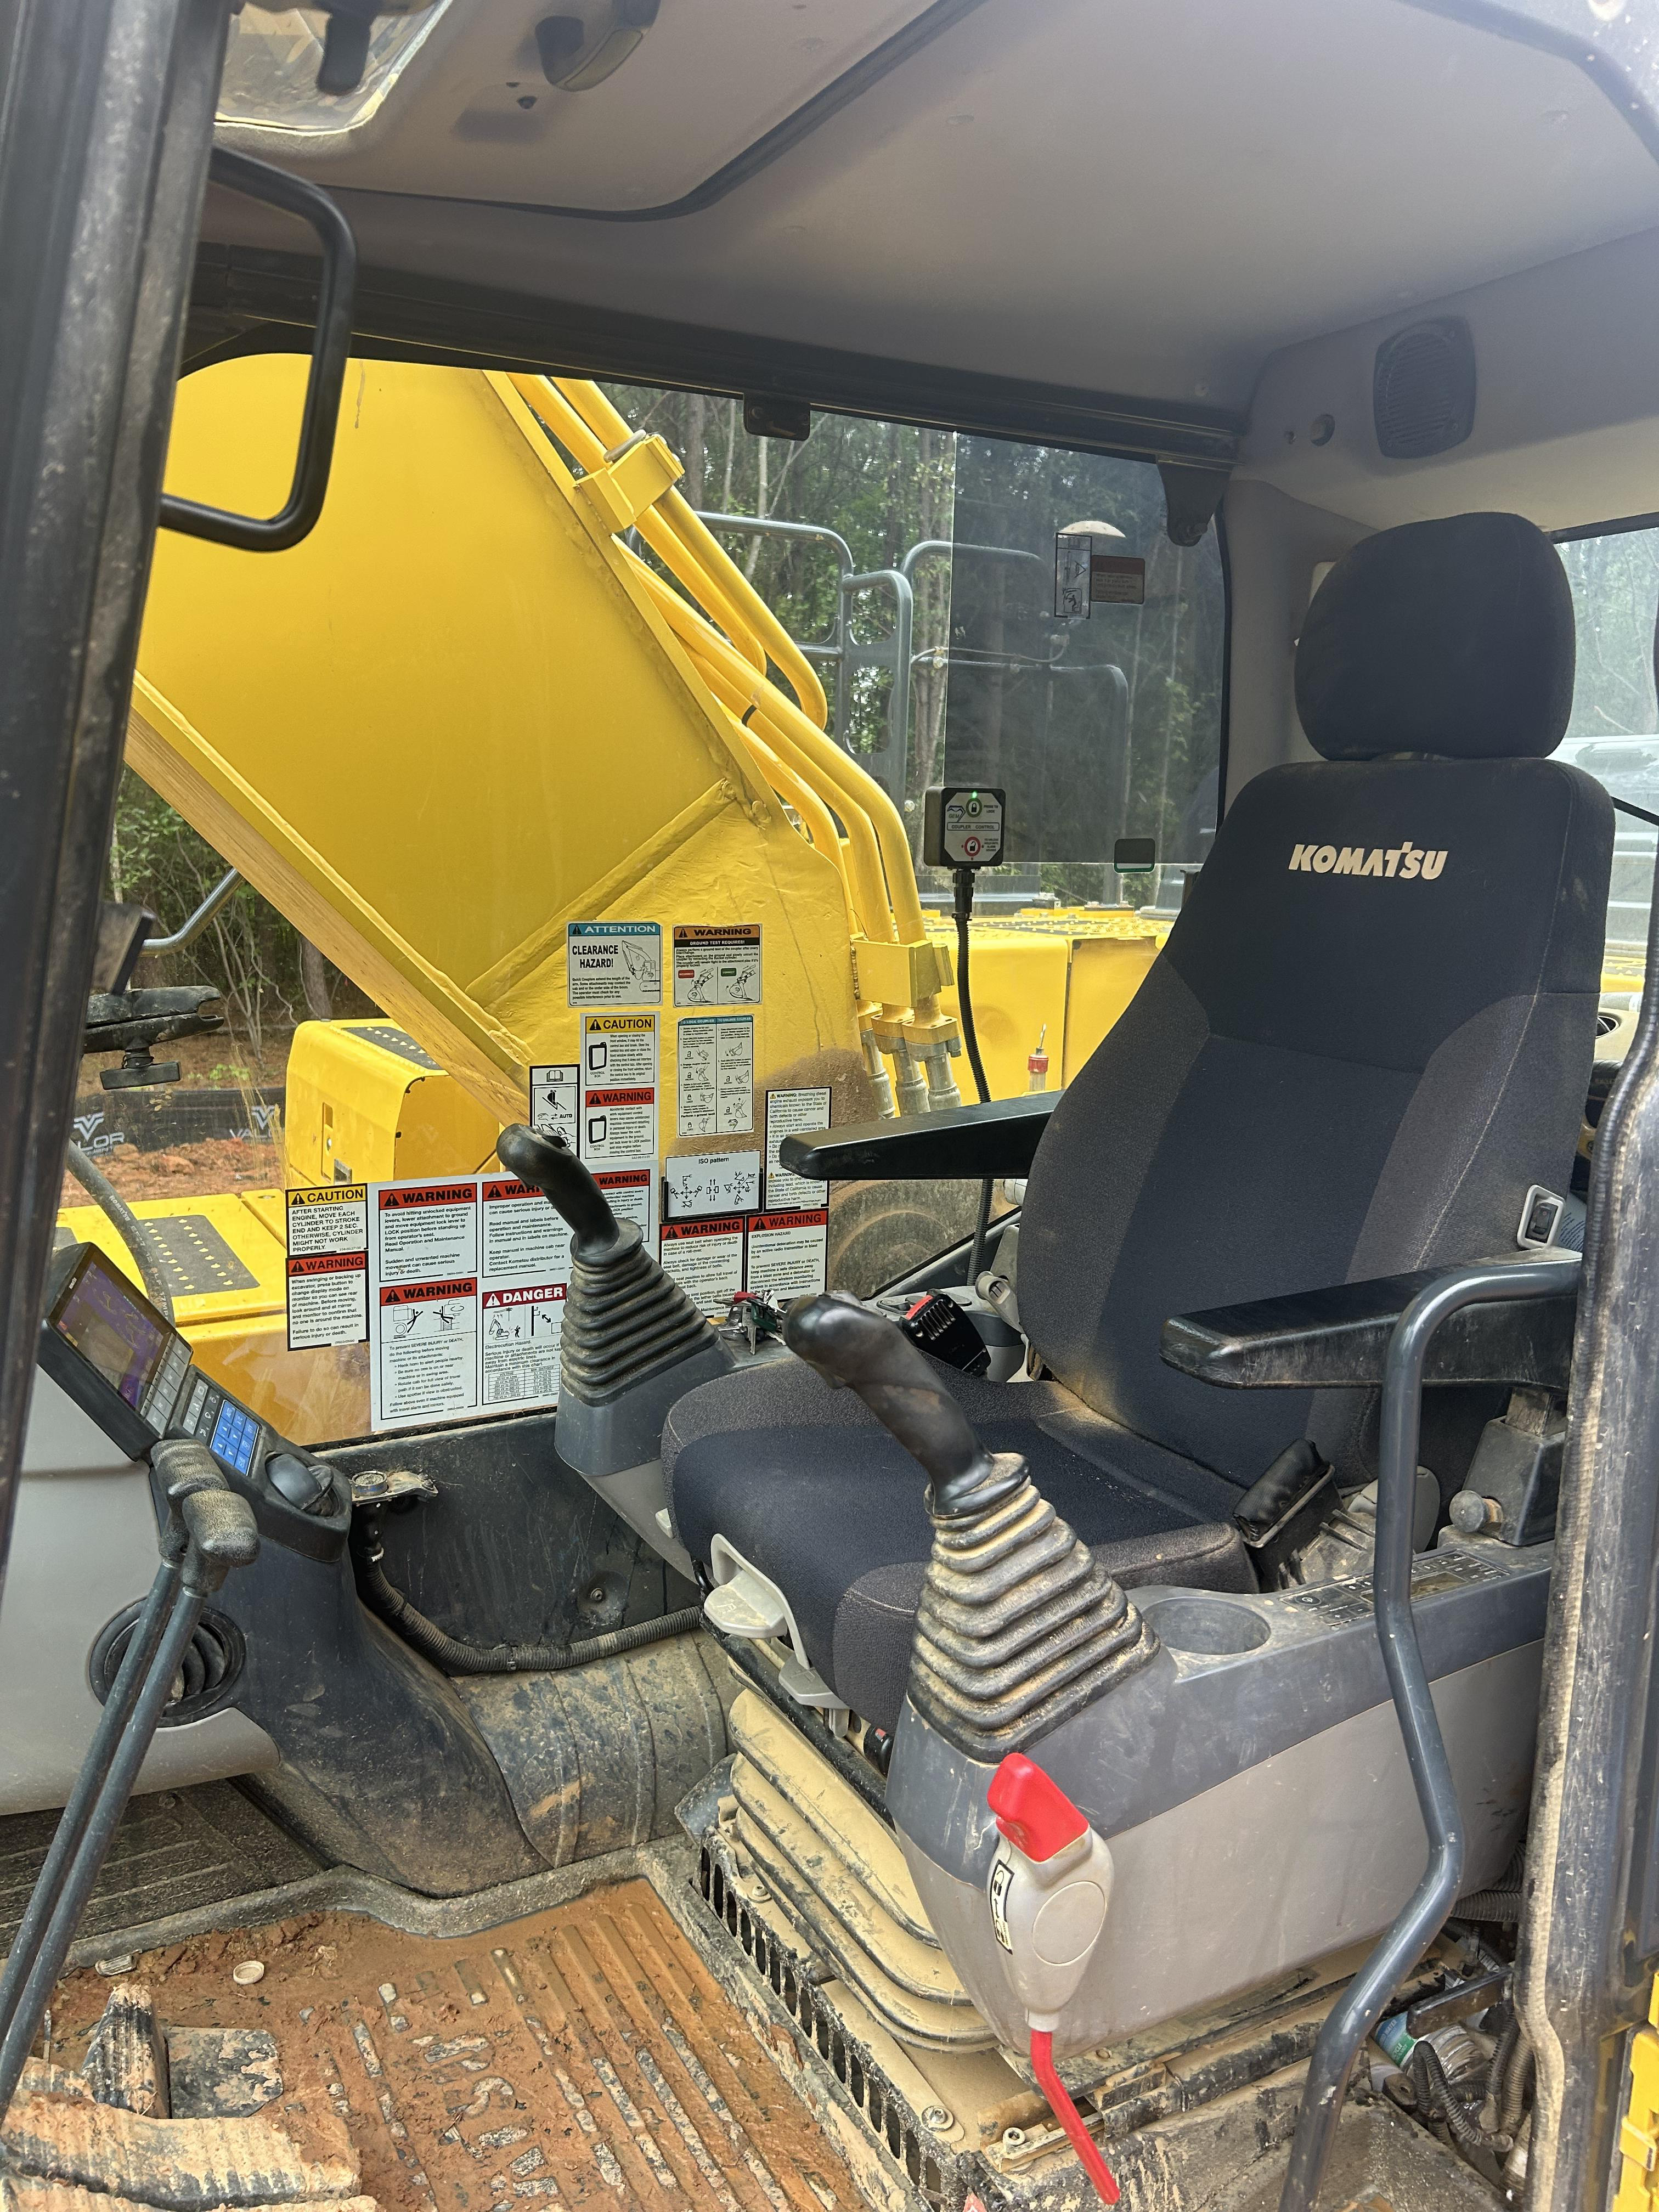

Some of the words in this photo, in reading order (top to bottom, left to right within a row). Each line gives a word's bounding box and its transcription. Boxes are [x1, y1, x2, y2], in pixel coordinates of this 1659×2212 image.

[1288, 842, 1448, 879] KOMATSU
[572, 945, 618, 955] CLEARANCE
[580, 958, 613, 968] HAZARD!
[603, 1019, 651, 1029] CAUTION
[603, 1092, 651, 1102] WARNING
[599, 1174, 647, 1185] WARNING
[307, 1189, 363, 1203] CAUTION
[403, 1188, 472, 1203] WARNING
[109, 1195, 131, 1221] KOMATSU
[769, 1214, 821, 1227] WARNING
[681, 1221, 740, 1235] WARNING
[306, 1256, 363, 1270] WARNING
[404, 1283, 472, 1298] WARNING
[503, 1287, 563, 1303] DANGER
